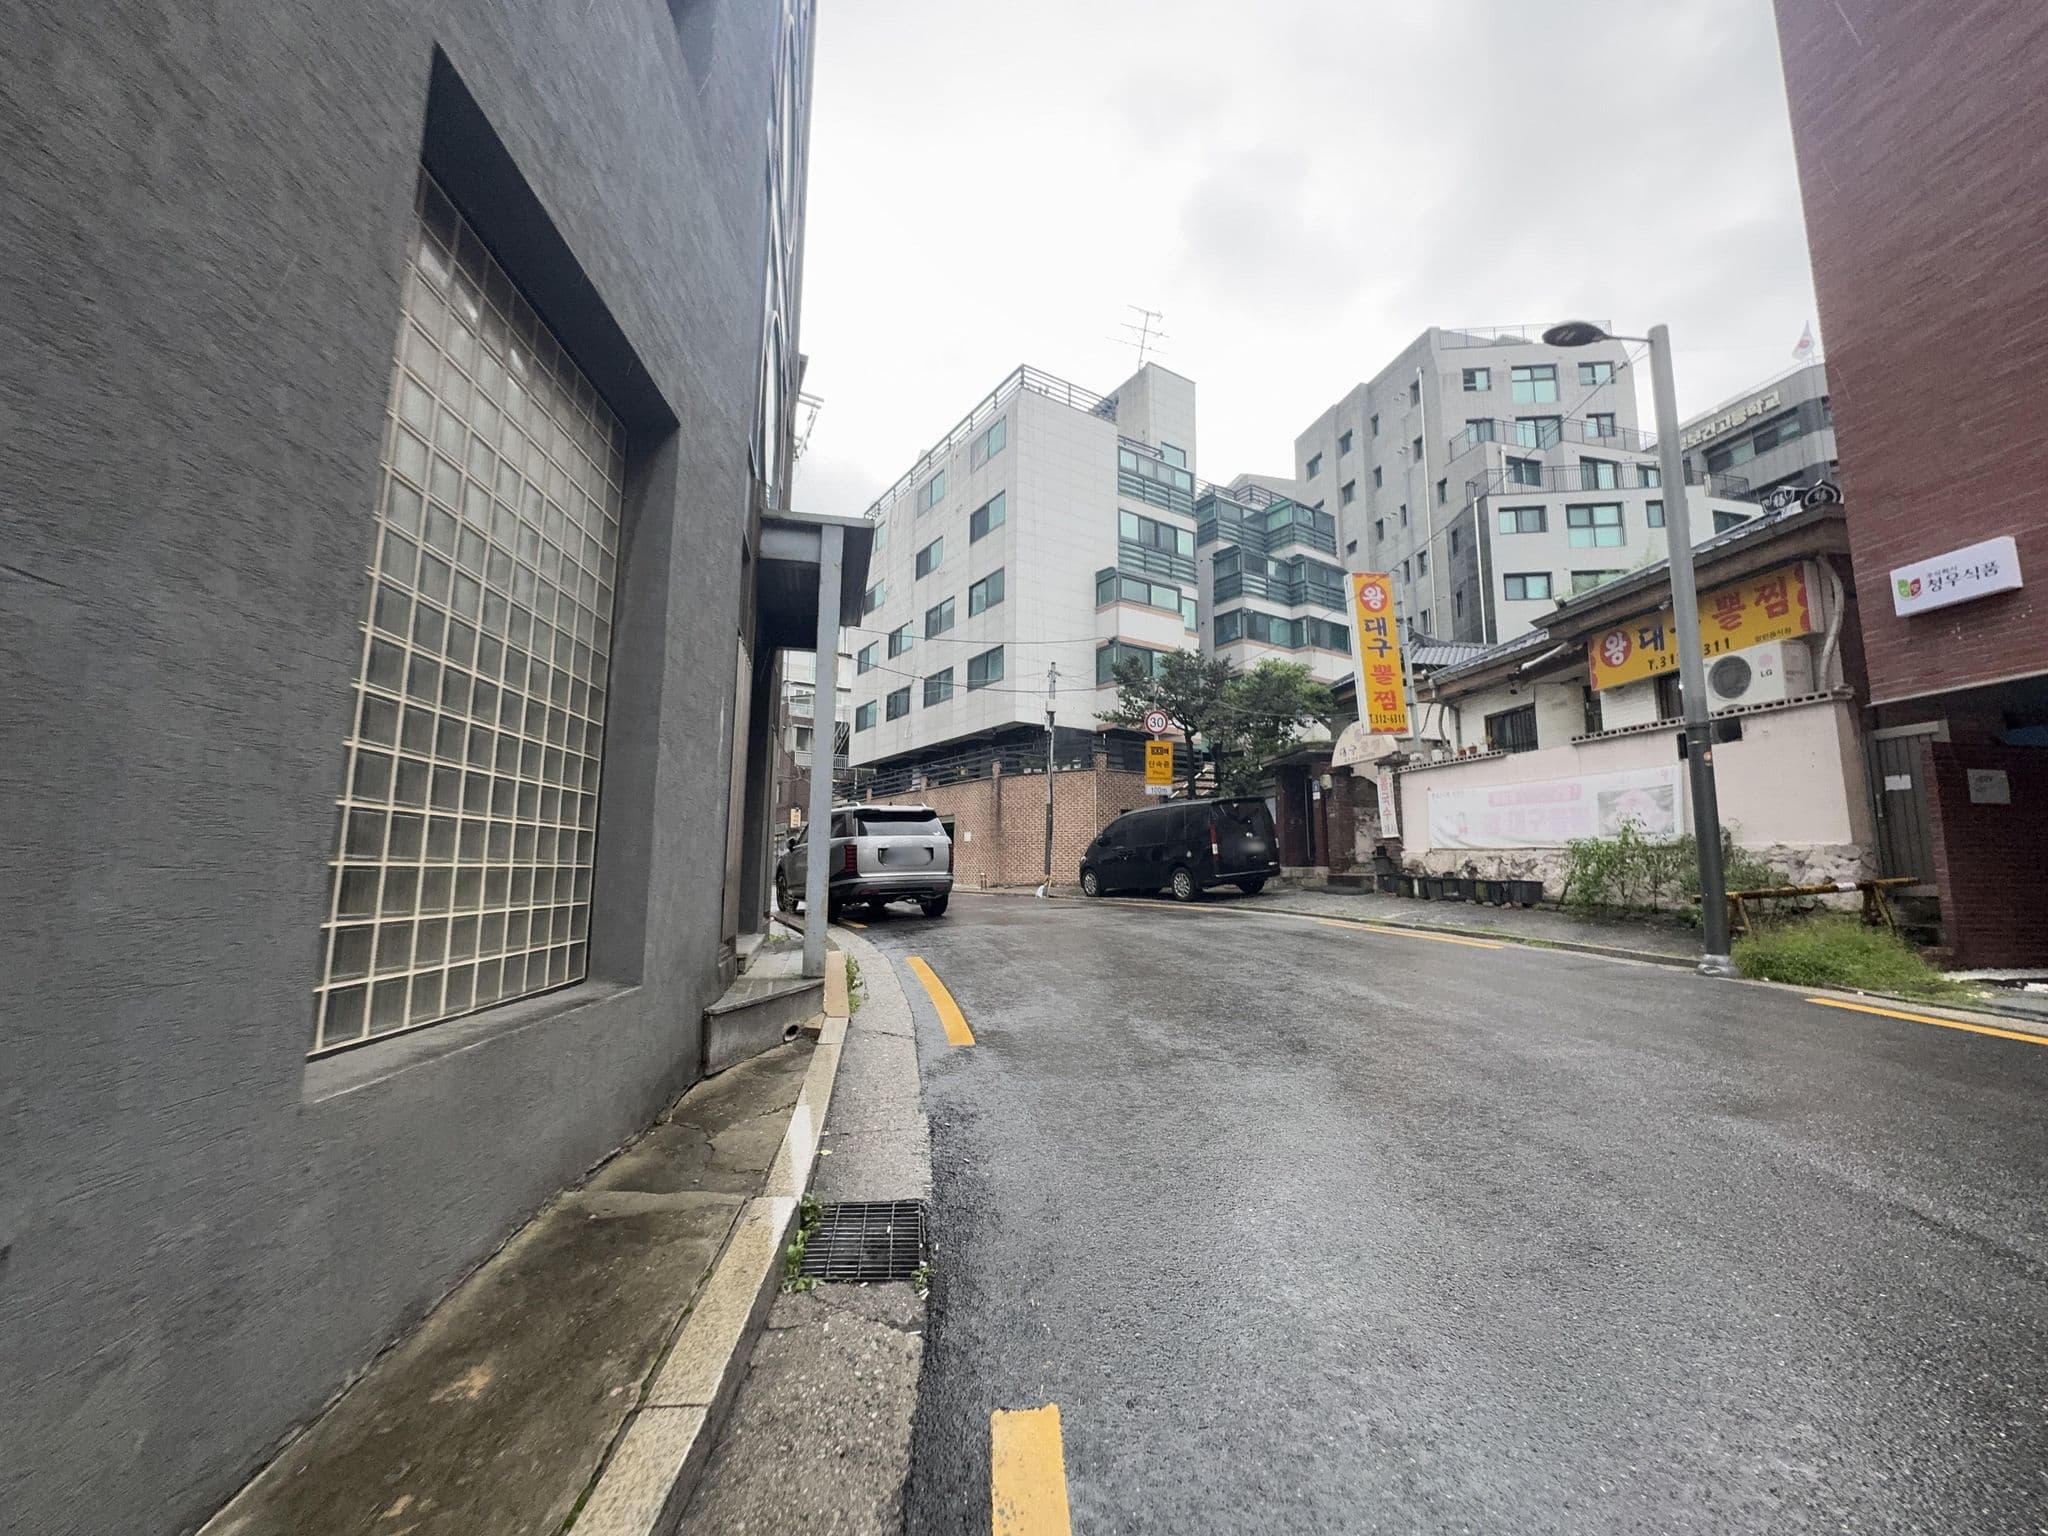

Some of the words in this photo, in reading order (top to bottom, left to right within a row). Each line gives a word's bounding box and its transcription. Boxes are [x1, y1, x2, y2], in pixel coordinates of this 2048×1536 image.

[1361, 585, 1385, 610] 왕
[1604, 631, 1628, 666] 왕
[1760, 667, 1774, 678] LG
[1150, 716, 1165, 729] 30
[1151, 786, 1168, 794] 100m
